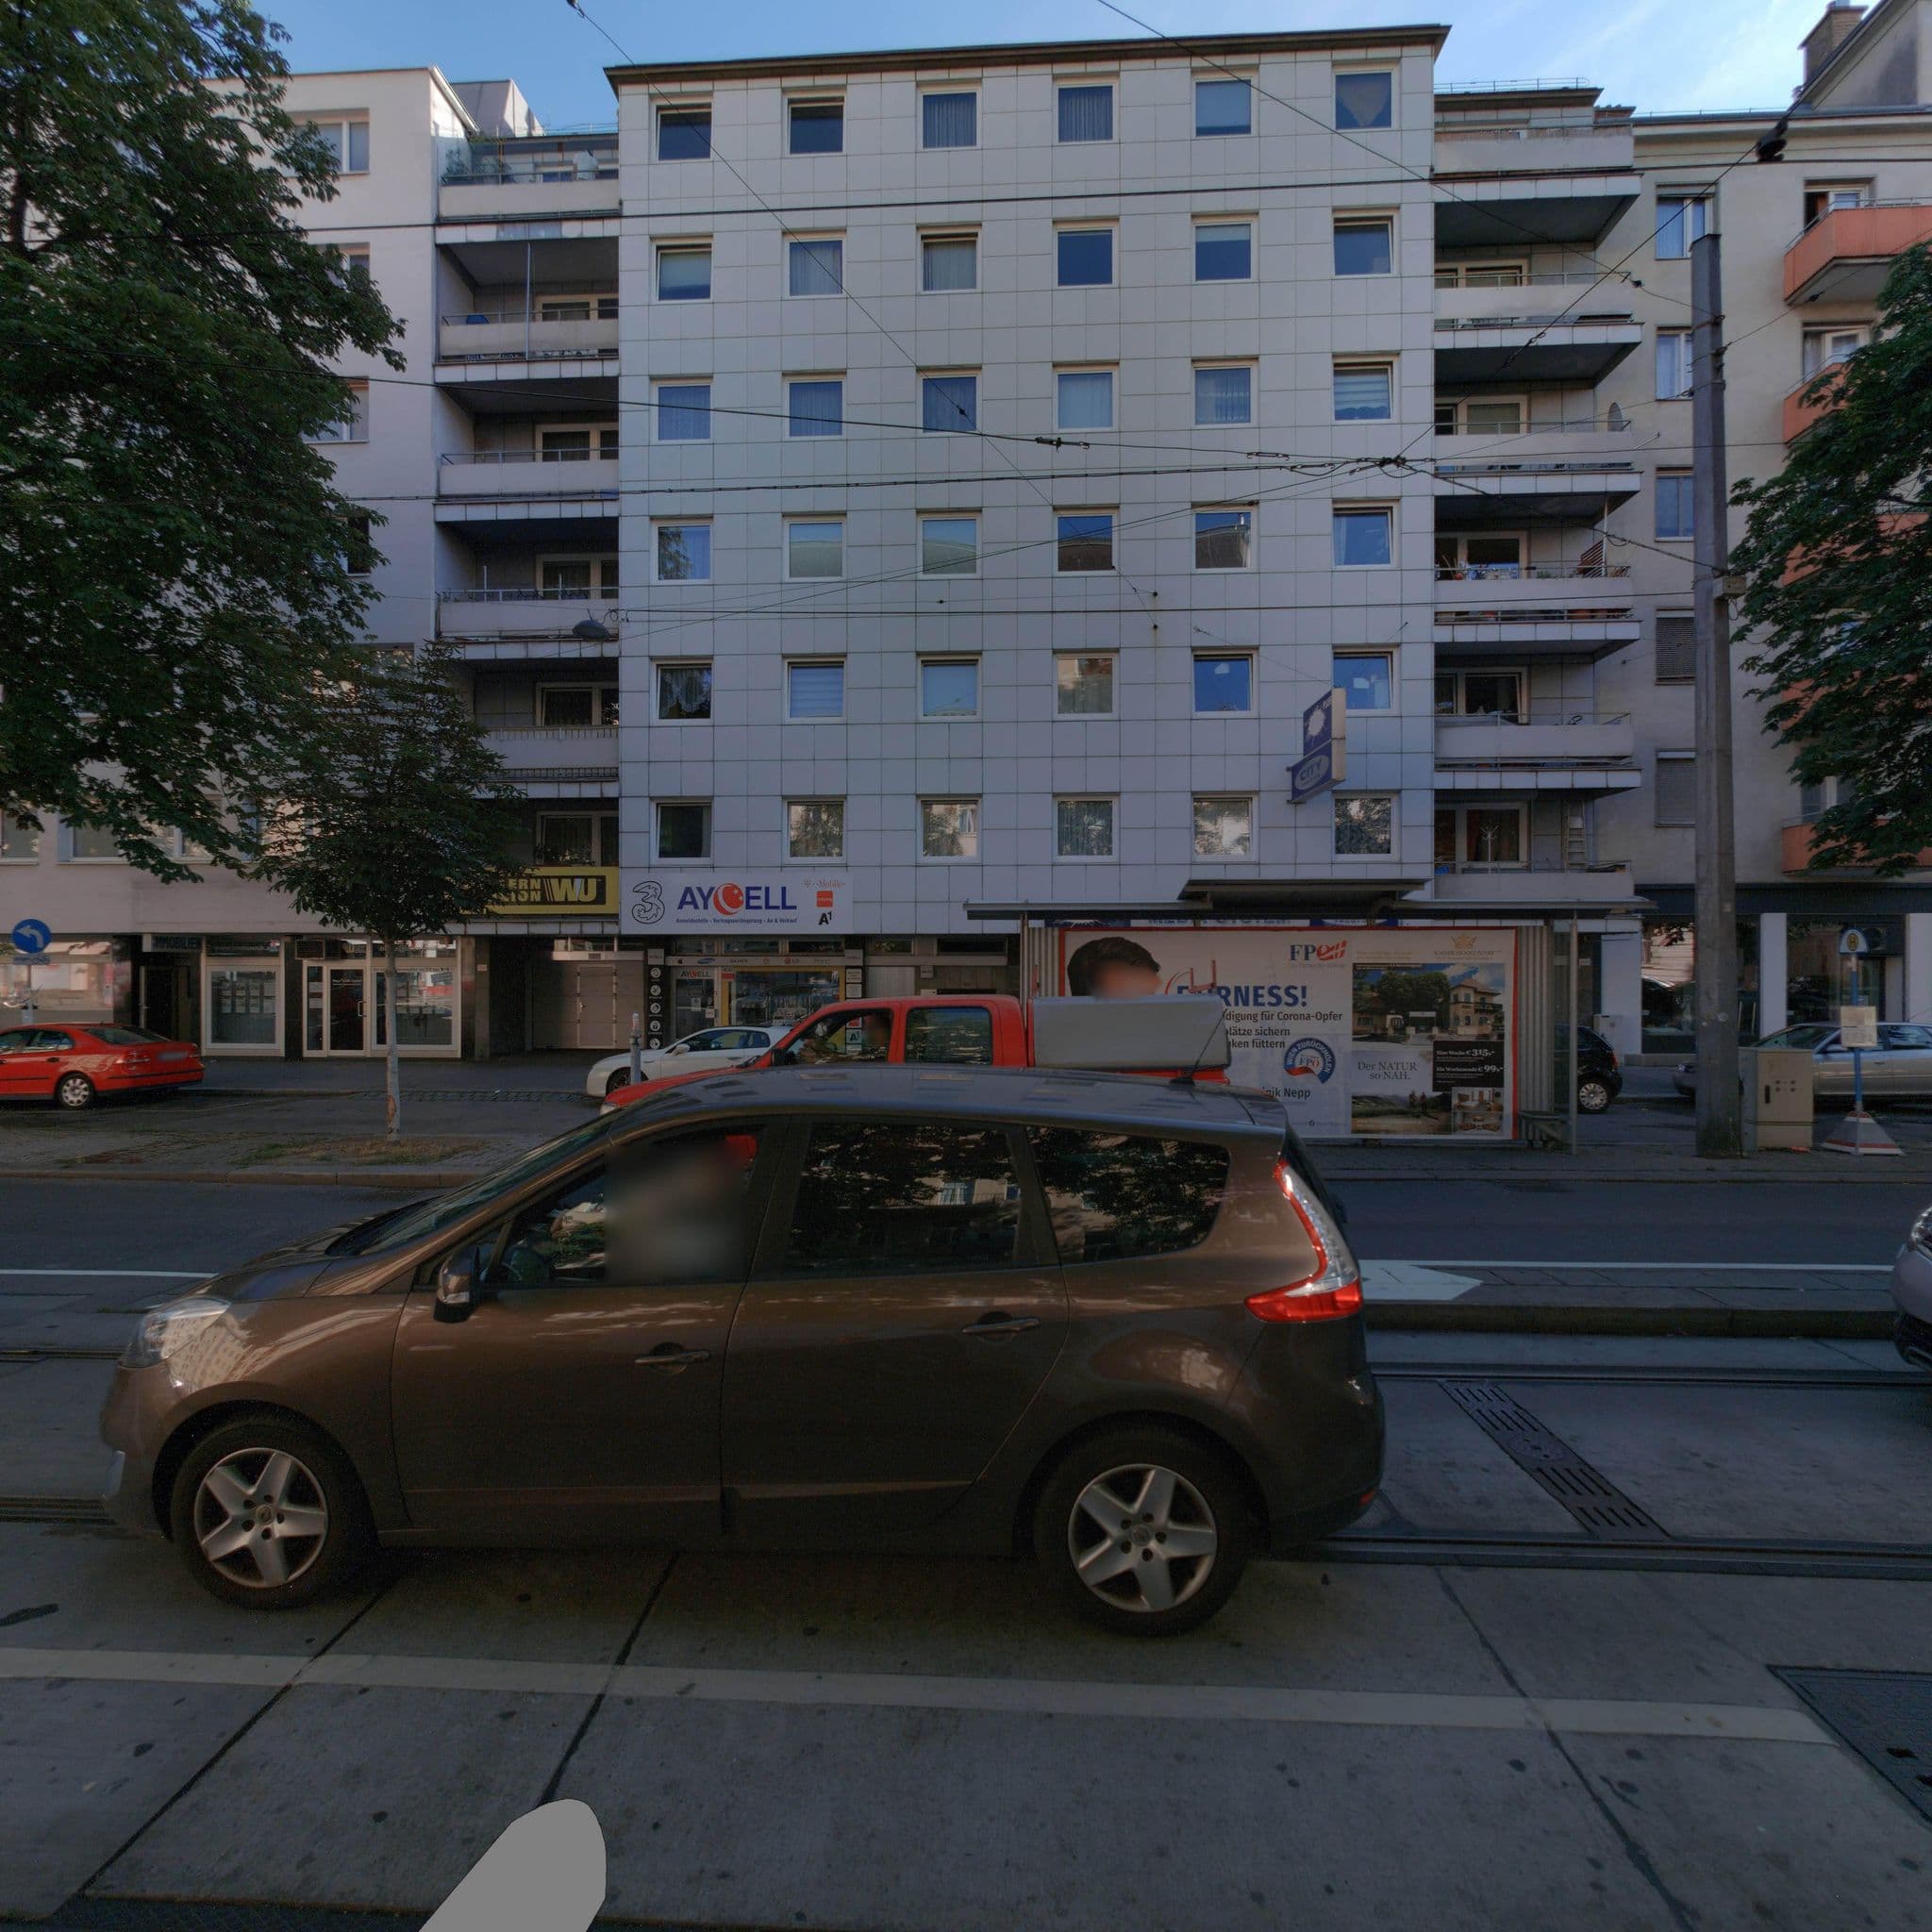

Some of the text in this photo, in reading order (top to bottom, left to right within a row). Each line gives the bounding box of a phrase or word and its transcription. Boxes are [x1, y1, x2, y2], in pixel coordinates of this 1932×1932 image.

[551, 877, 597, 902] WU
[631, 880, 666, 924] 3
[819, 911, 832, 925] A1
[1224, 1010, 1343, 1023] digung für Corona-Opfer
[1227, 1026, 1291, 1036] lätze sichern
[1229, 1039, 1285, 1048] ken füttern
[1357, 1061, 1418, 1071] Der NATUR
[1369, 1072, 1380, 1080] so
[1284, 1087, 1311, 1100] Nepp
